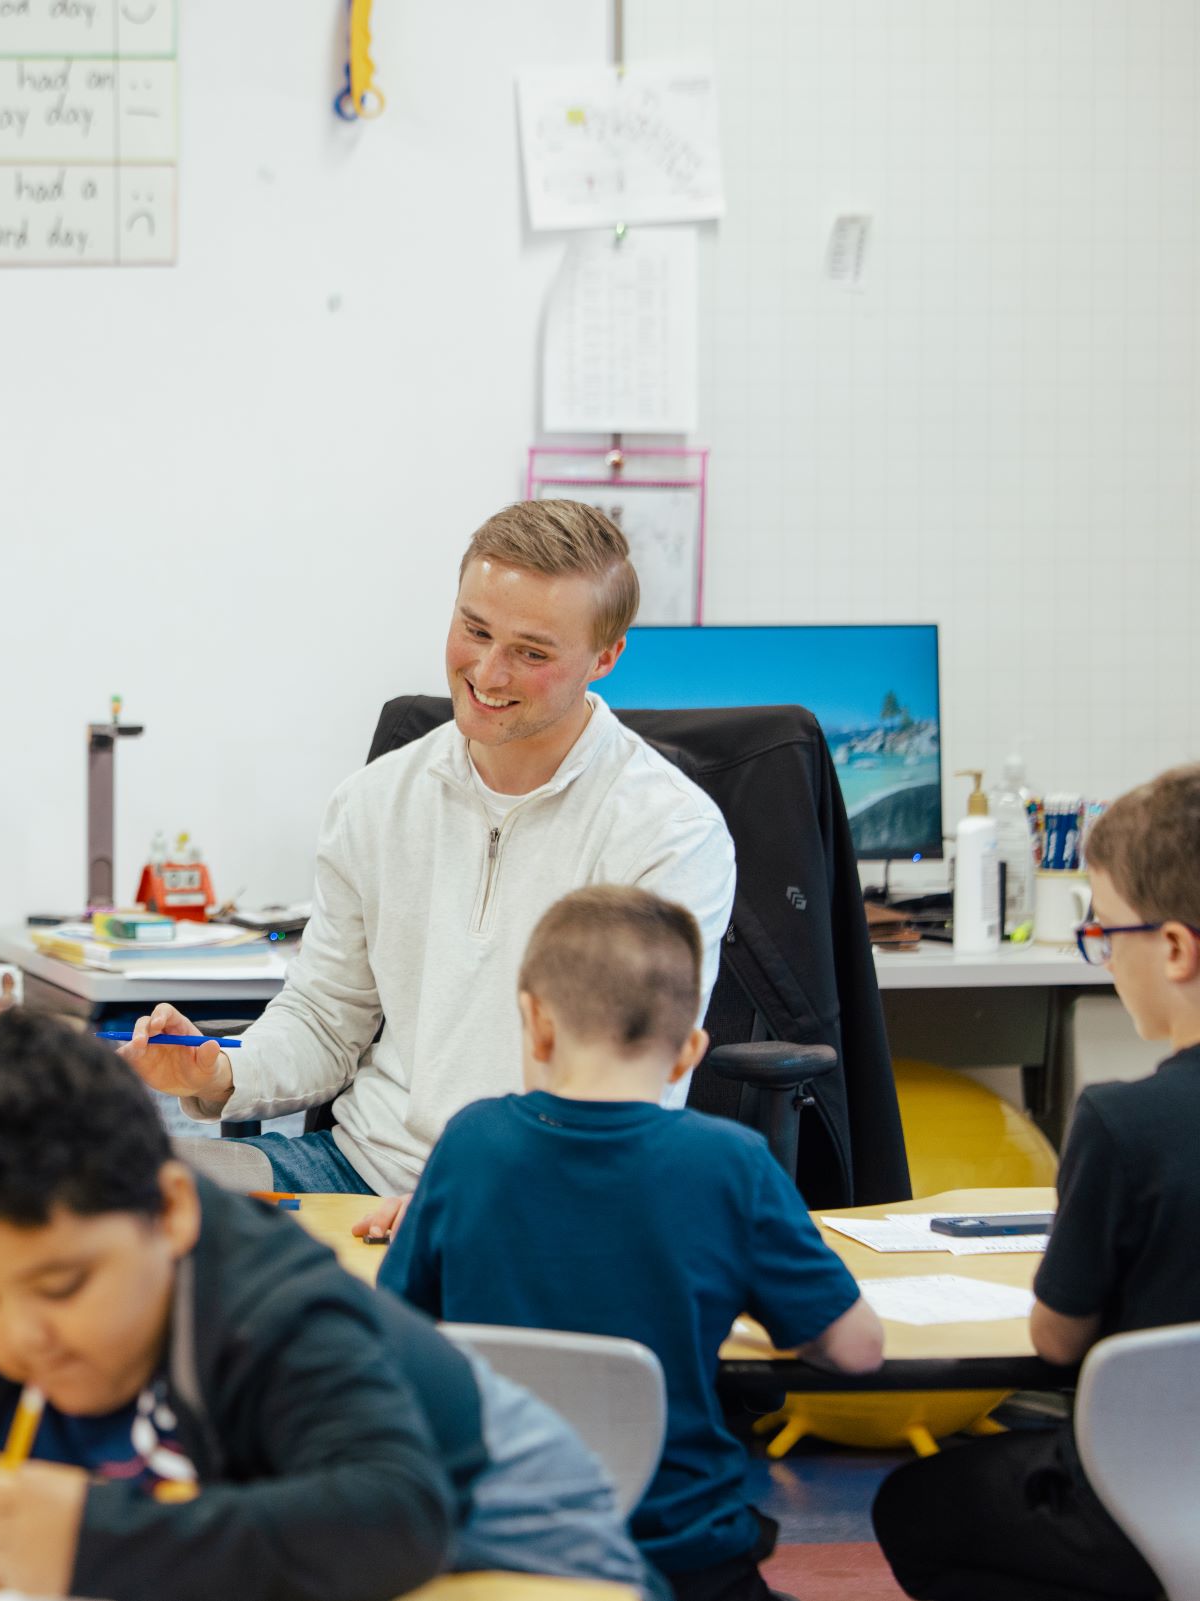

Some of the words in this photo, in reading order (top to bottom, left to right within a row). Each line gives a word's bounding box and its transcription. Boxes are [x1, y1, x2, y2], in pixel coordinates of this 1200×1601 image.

[49, 0, 96, 29] day
[16, 57, 71, 91] had
[86, 69, 115, 89] an
[44, 92, 94, 139] day
[14, 166, 66, 203] had
[80, 177, 98, 201] a
